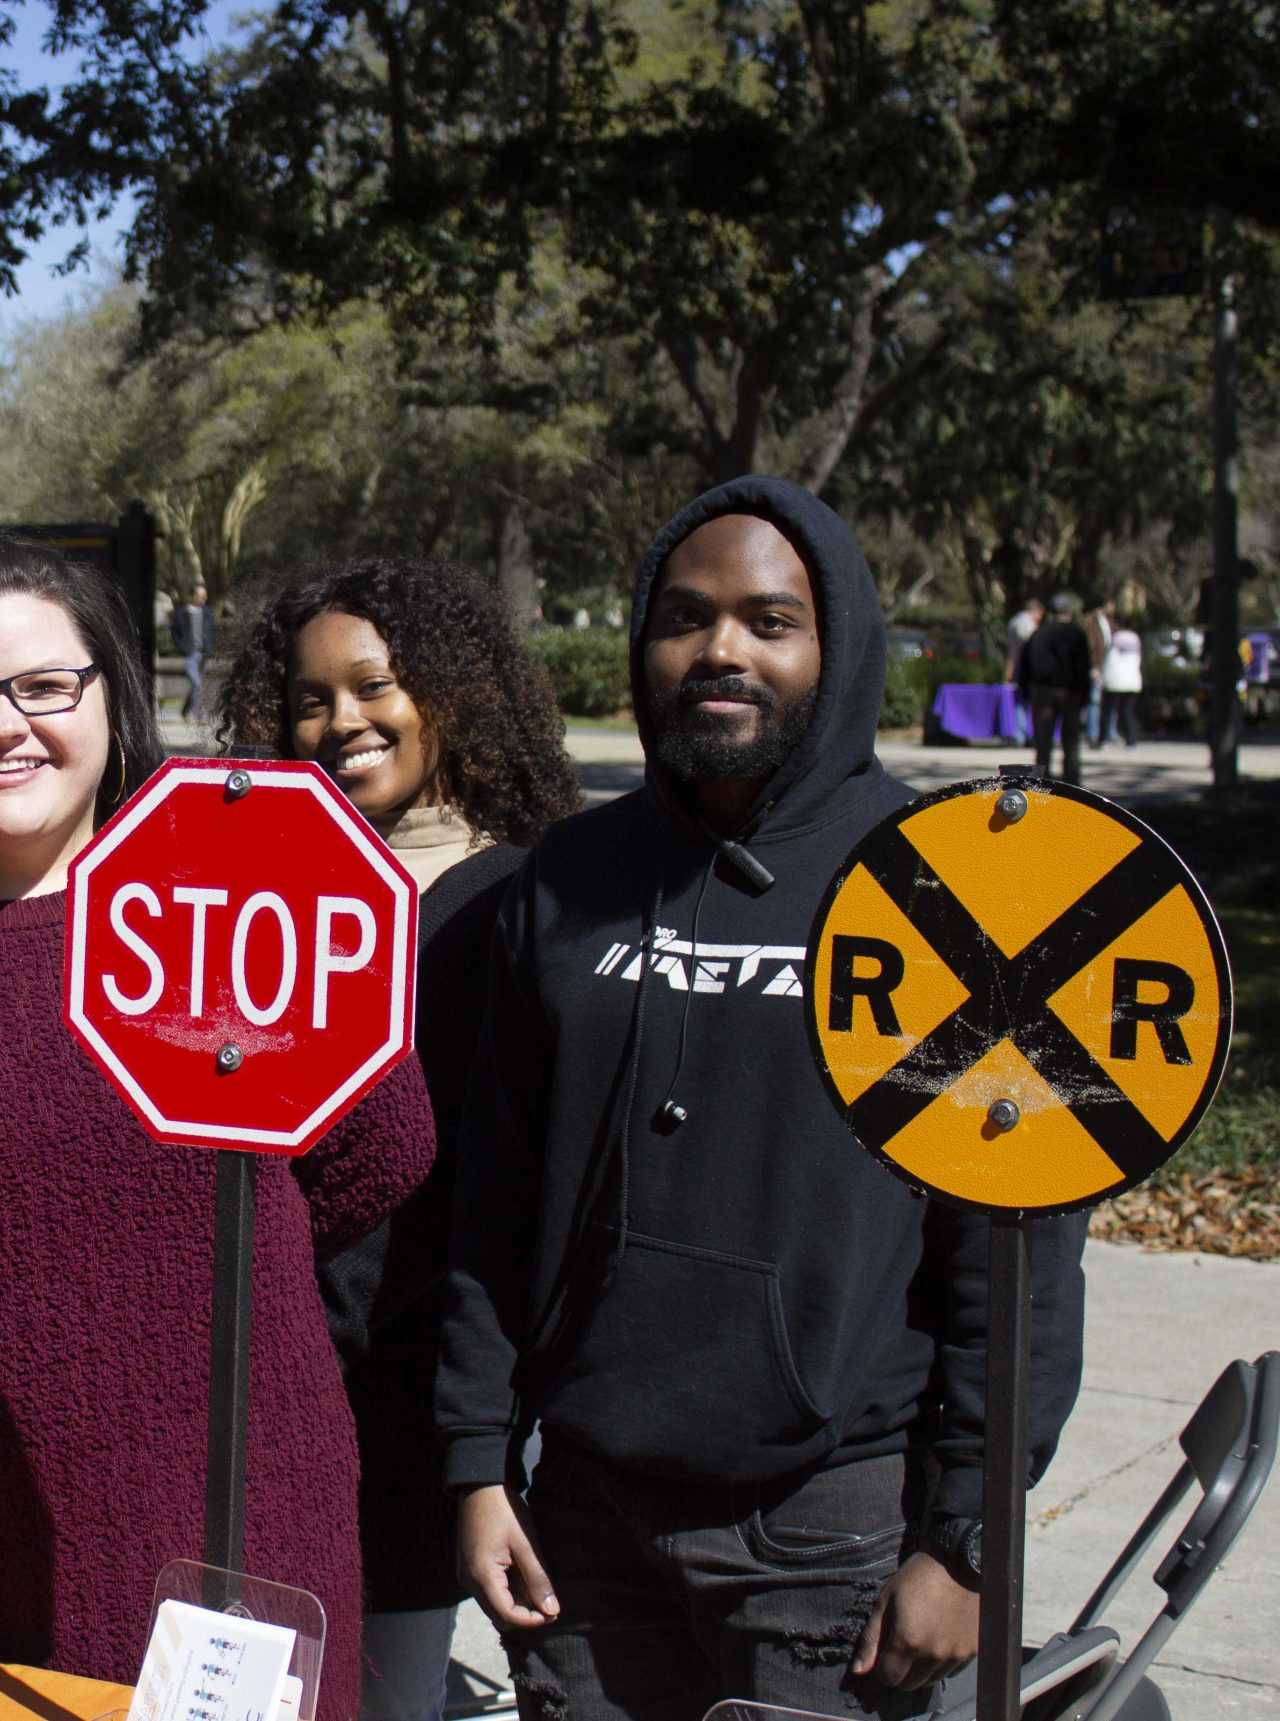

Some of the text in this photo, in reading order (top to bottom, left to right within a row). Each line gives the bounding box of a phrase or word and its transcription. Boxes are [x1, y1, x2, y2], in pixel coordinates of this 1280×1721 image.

[101, 882, 378, 1030] STOP
[829, 934, 1196, 1066] R R
